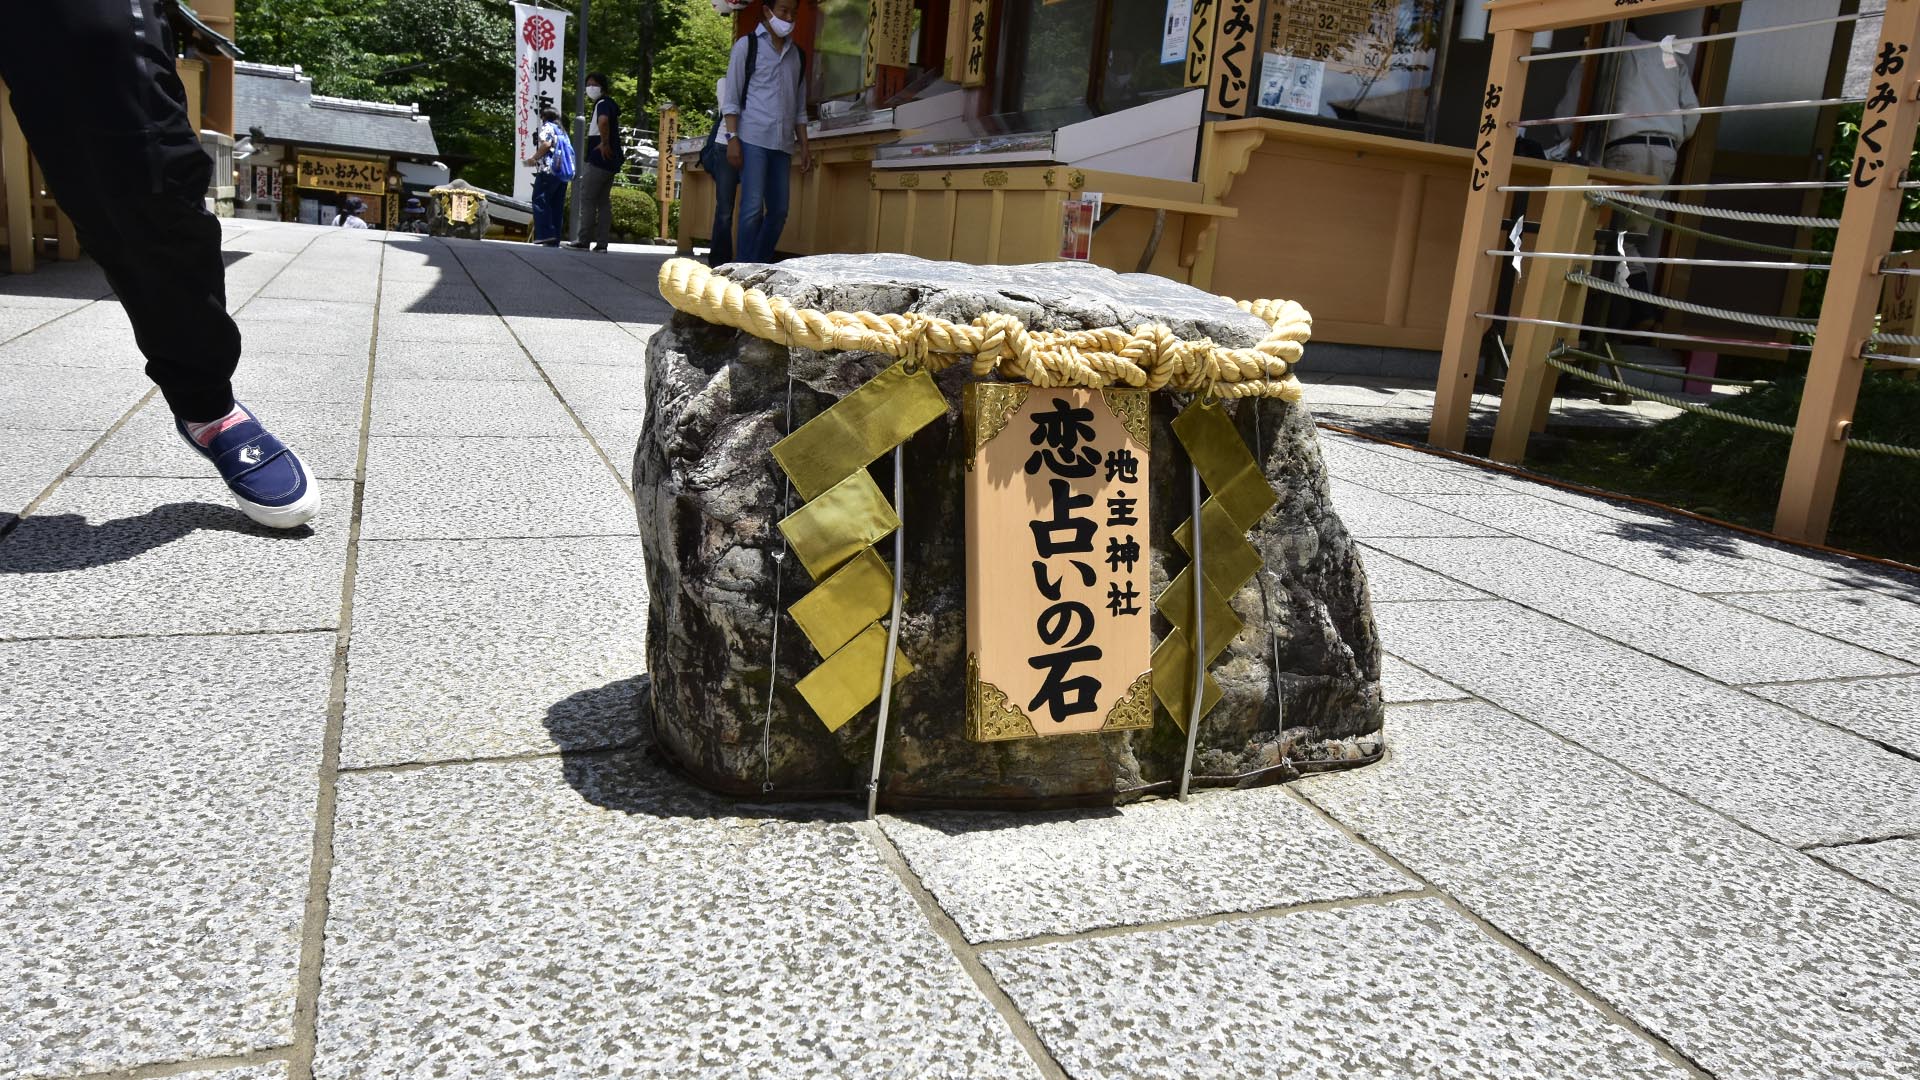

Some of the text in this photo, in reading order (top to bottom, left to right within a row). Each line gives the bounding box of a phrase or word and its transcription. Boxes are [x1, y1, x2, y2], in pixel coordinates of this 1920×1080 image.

[967, 0, 985, 75] 受付
[1218, 0, 1254, 108] みくじ
[1472, 83, 1503, 192] おみくじ
[1854, 42, 1908, 188] おみくじ
[302, 161, 383, 182] 恋占いおみくじ
[1024, 398, 1103, 723] 恋占いの石
[1104, 449, 1142, 617] 地主神社
